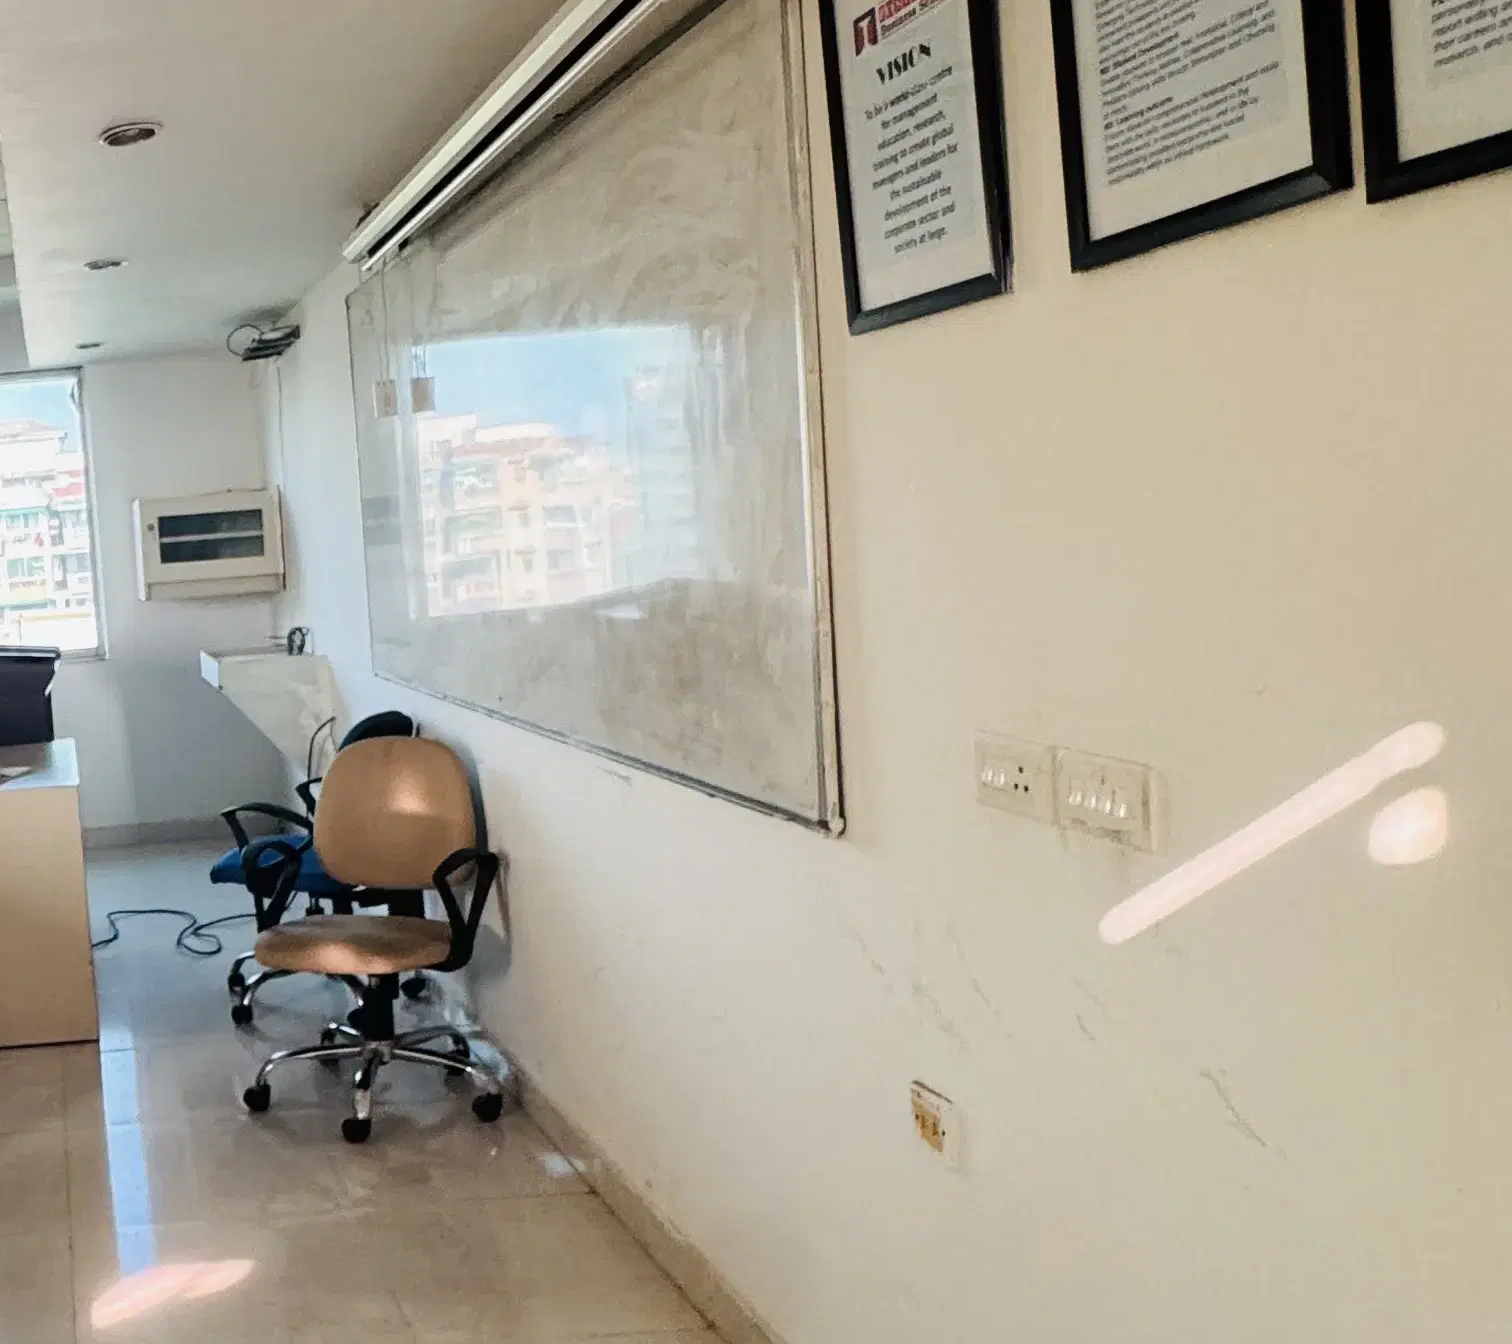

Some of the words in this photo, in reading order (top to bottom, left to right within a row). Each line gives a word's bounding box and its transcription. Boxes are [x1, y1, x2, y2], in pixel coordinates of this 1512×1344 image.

[880, 7, 917, 36] Business
[875, 43, 932, 85] VISION
[874, 102, 883, 117] be
[881, 119, 891, 130] for
[892, 93, 937, 125] management
[872, 153, 898, 172] training
[908, 136, 929, 155] create
[932, 122, 954, 146] global
[877, 128, 912, 151] education,
[872, 169, 904, 191] managers
[905, 160, 918, 175] and
[919, 149, 946, 168] leaders
[947, 141, 958, 155] for
[884, 194, 929, 222] development
[929, 188, 938, 202] of
[939, 185, 952, 198] the
[889, 189, 901, 201] the
[902, 169, 942, 195] sustainable
[884, 219, 917, 240] corporate
[918, 209, 940, 226] sector
[941, 200, 955, 217] and
[894, 237, 918, 255] society
